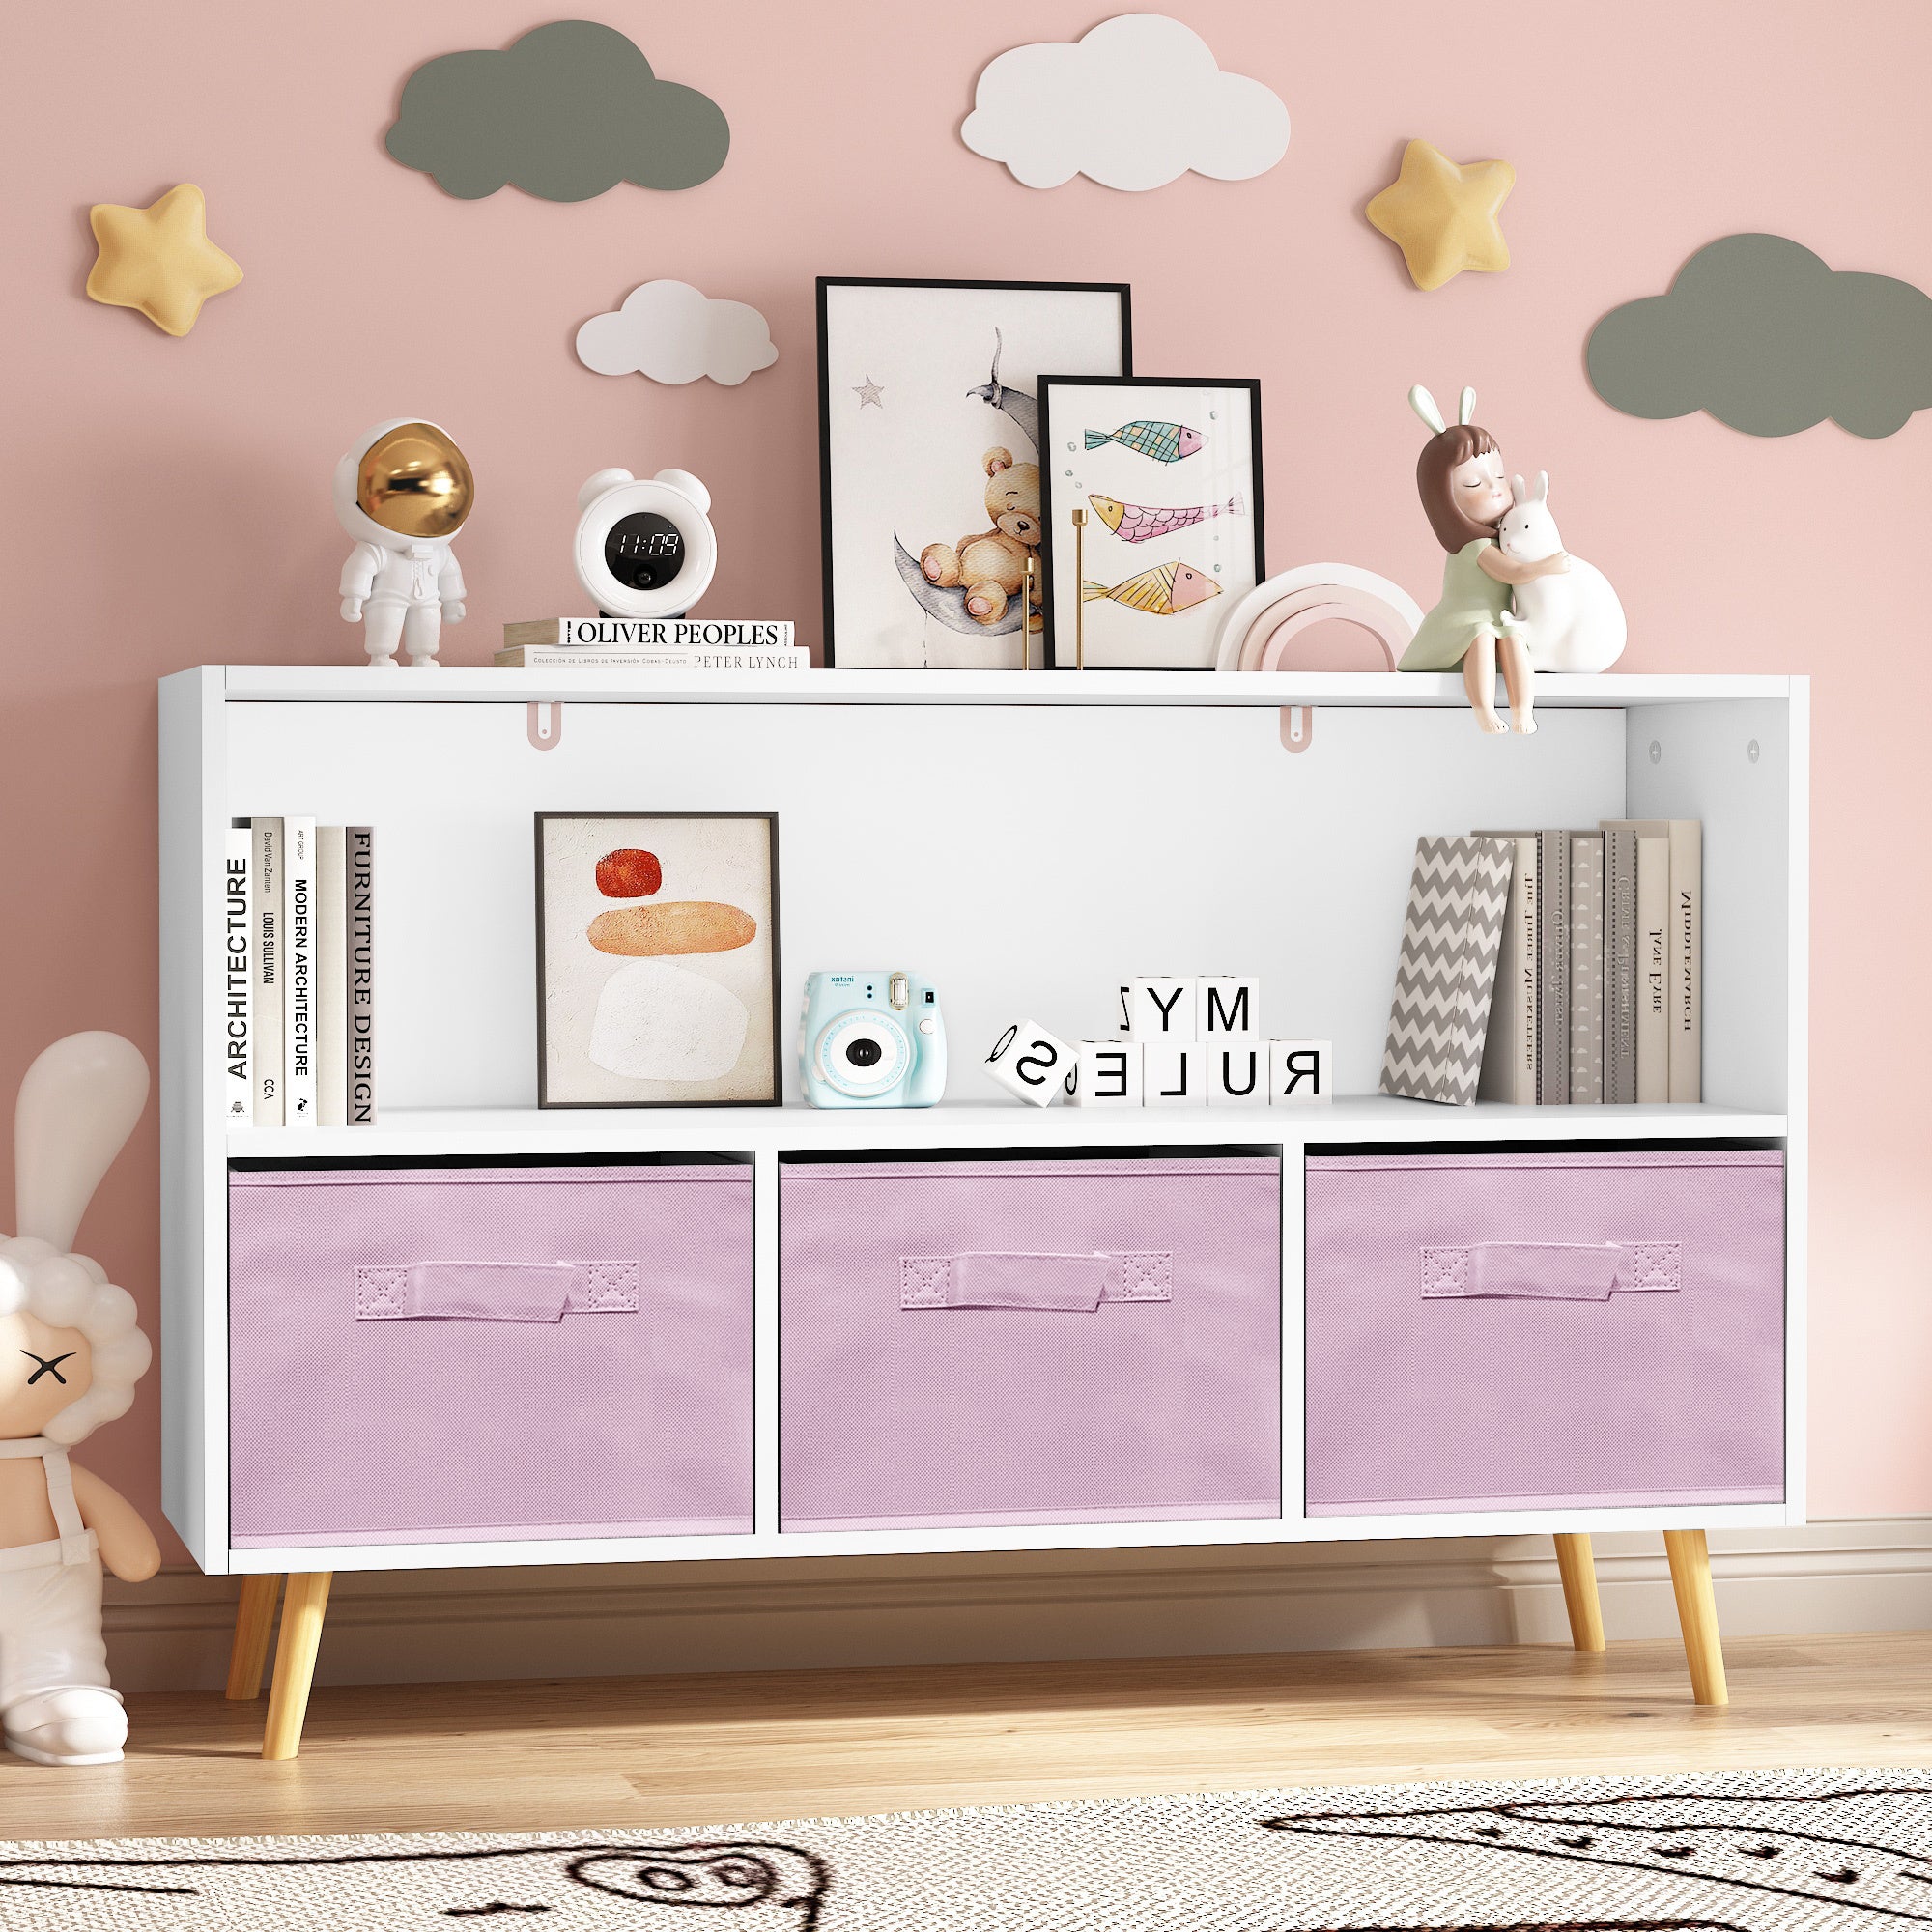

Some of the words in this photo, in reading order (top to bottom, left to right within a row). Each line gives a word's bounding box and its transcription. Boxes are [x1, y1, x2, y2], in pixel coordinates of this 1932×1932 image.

[619, 533, 679, 555] 11:09
[577, 622, 667, 644] OLIVER
[673, 623, 779, 645] PEOPLES
[694, 656, 743, 668] PETER
[748, 656, 799, 669] LYNCH
[264, 832, 273, 852] David
[264, 853, 273, 867] Van
[264, 867, 273, 894] Zanten
[262, 912, 274, 939] LOUIS
[295, 879, 307, 948] MODERN
[354, 832, 371, 1005] FURNITURE
[226, 858, 247, 1080] ARCHITECTURE
[262, 941, 274, 984] SULLIVAN
[295, 952, 308, 1076] ARCHITECTURE
[355, 1014, 372, 1122] DESIGN
[263, 1078, 275, 1100] CCA
